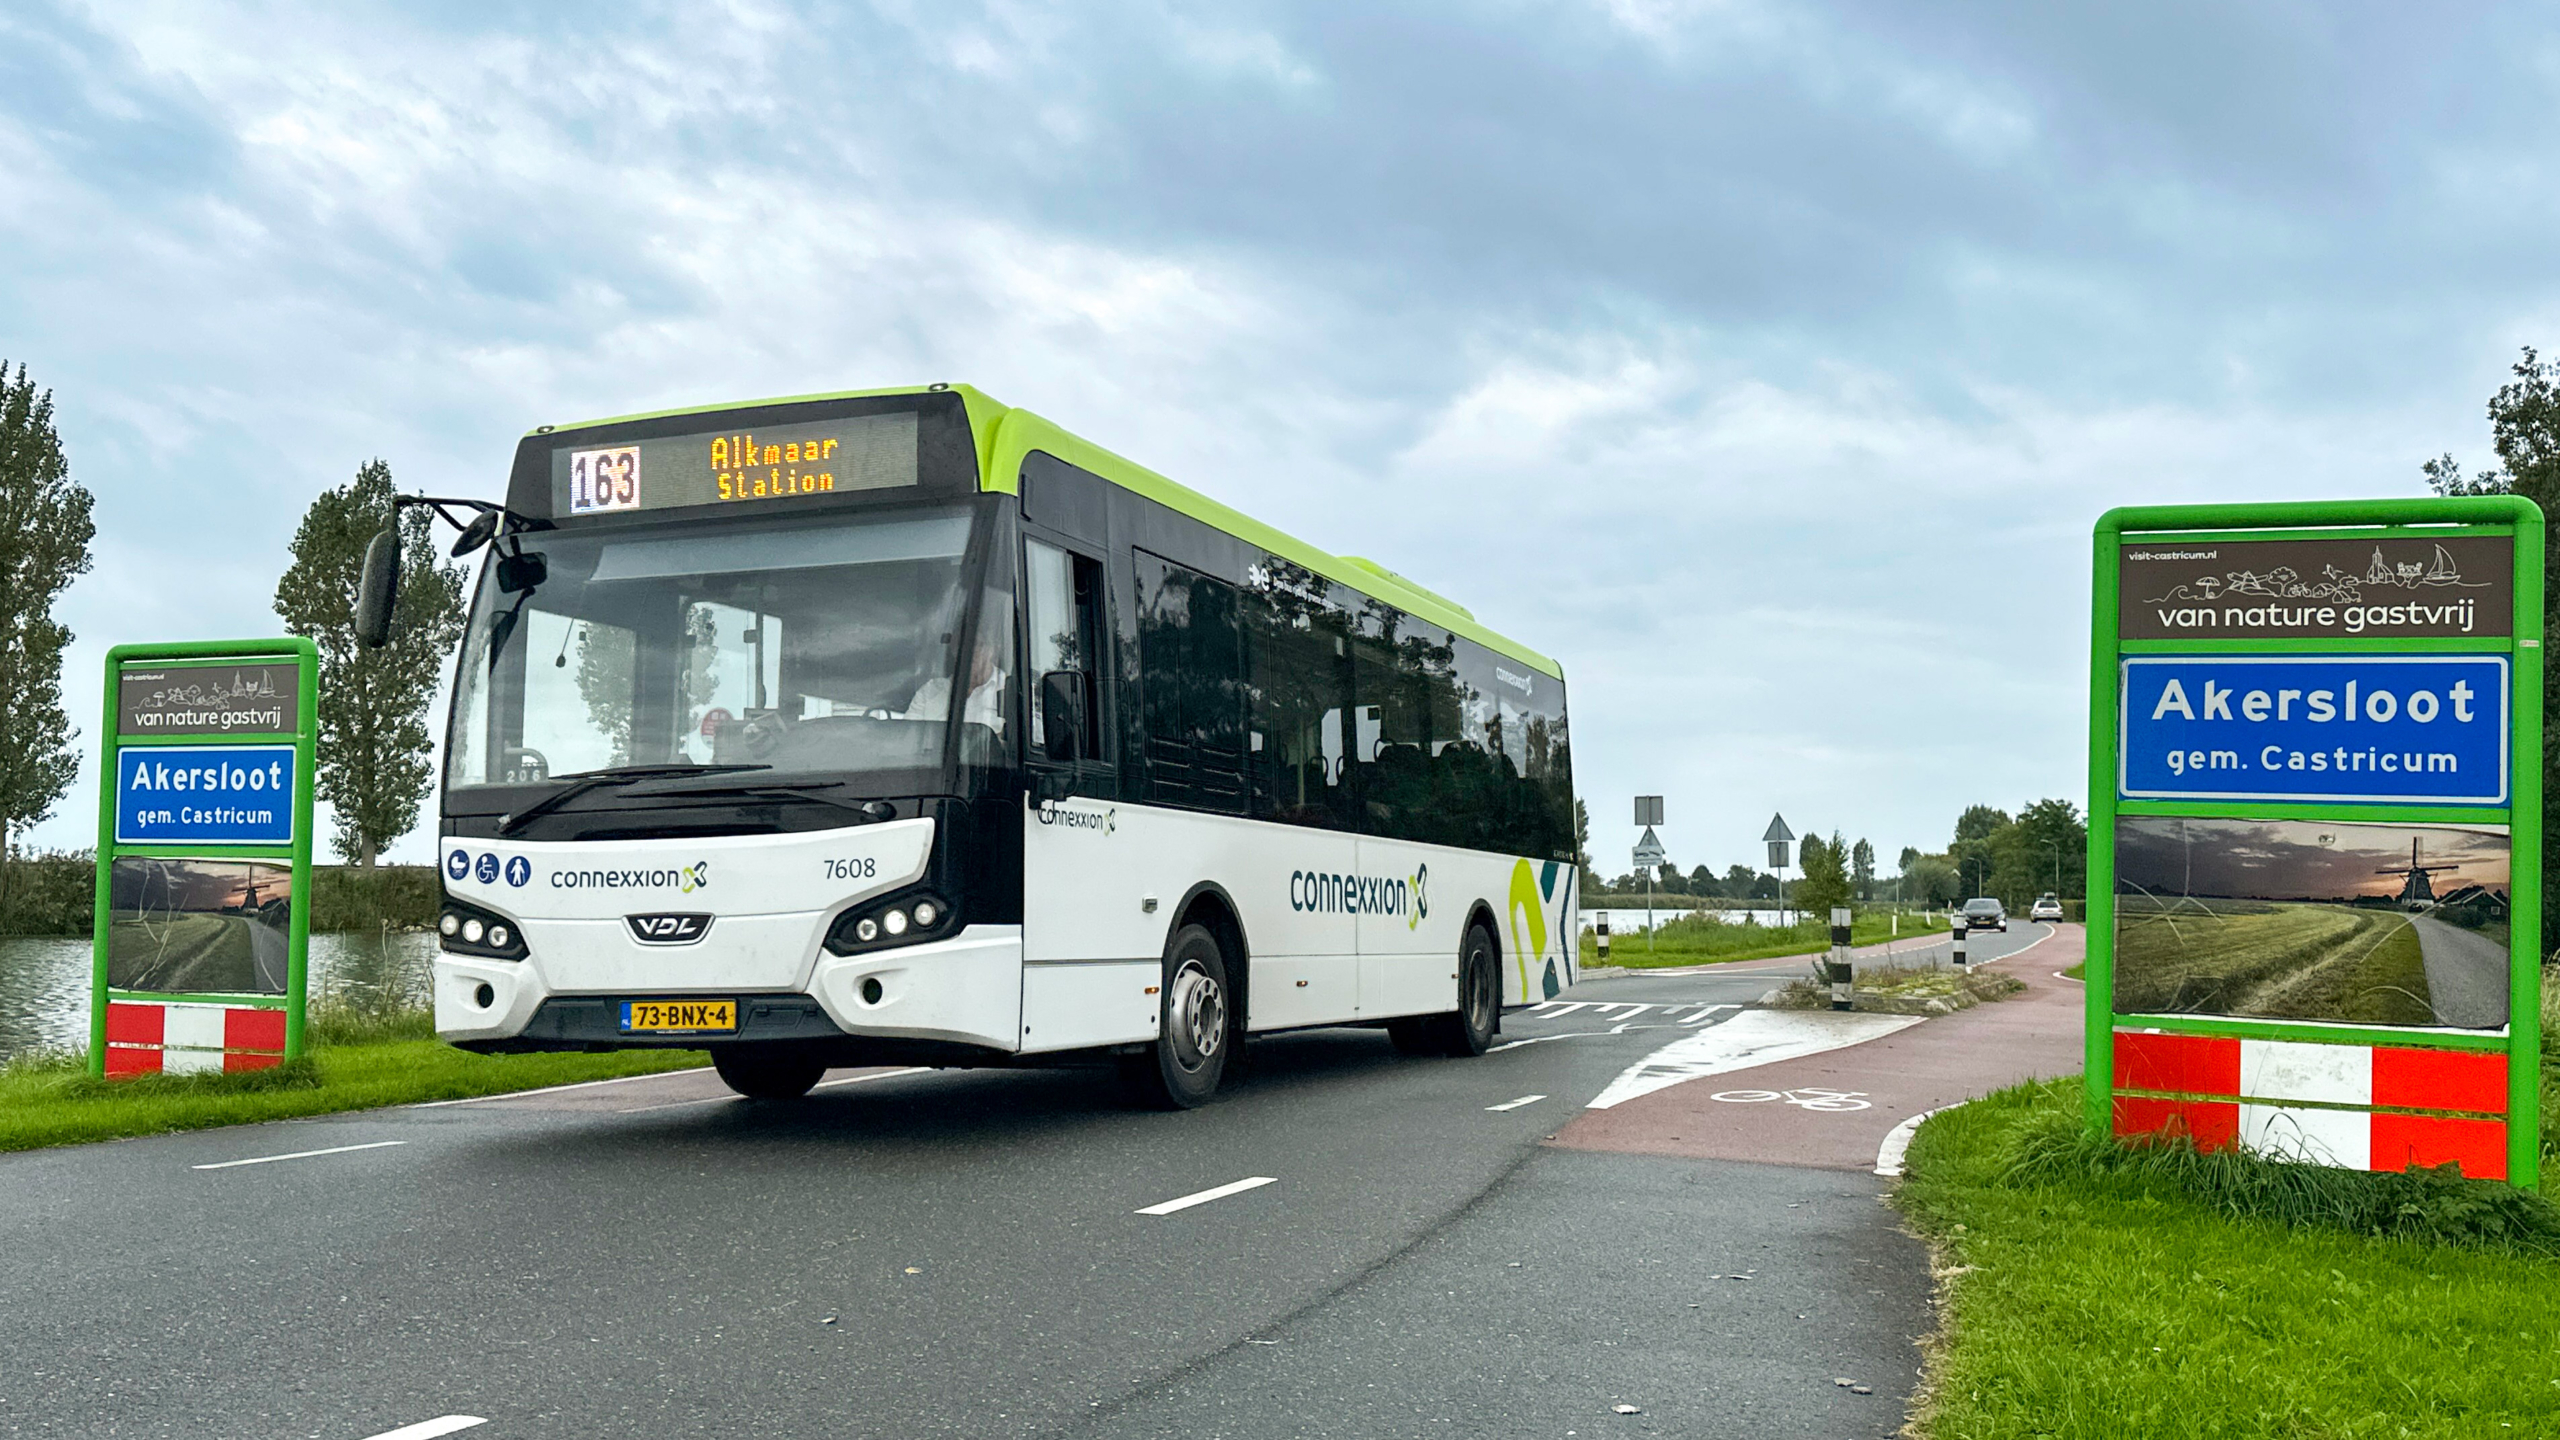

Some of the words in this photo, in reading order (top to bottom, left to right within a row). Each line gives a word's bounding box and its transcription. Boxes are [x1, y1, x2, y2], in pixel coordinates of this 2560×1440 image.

[710, 435, 838, 469] Alkmaar
[574, 453, 634, 508] 163
[718, 468, 833, 499] Station
[2129, 550, 2217, 562] visit-castricum.nl
[2157, 606, 2216, 628] van
[2225, 603, 2335, 627] nature
[2344, 599, 2475, 633] gastvrij
[2151, 678, 2475, 724] Akersloot
[135, 711, 163, 726] van
[166, 709, 218, 726] nature
[221, 706, 281, 729] gastvrij
[131, 761, 282, 792] Akersloot
[2167, 751, 2248, 777] gem.
[2261, 745, 2458, 773] Castricum
[137, 810, 176, 829] gem.
[181, 806, 273, 825] Castricum
[550, 866, 680, 890] connexxion
[823, 857, 876, 880] 7608
[1290, 869, 1407, 916] connexxion
[636, 917, 698, 937] VDL
[637, 1005, 728, 1027] 73-BNX-4
